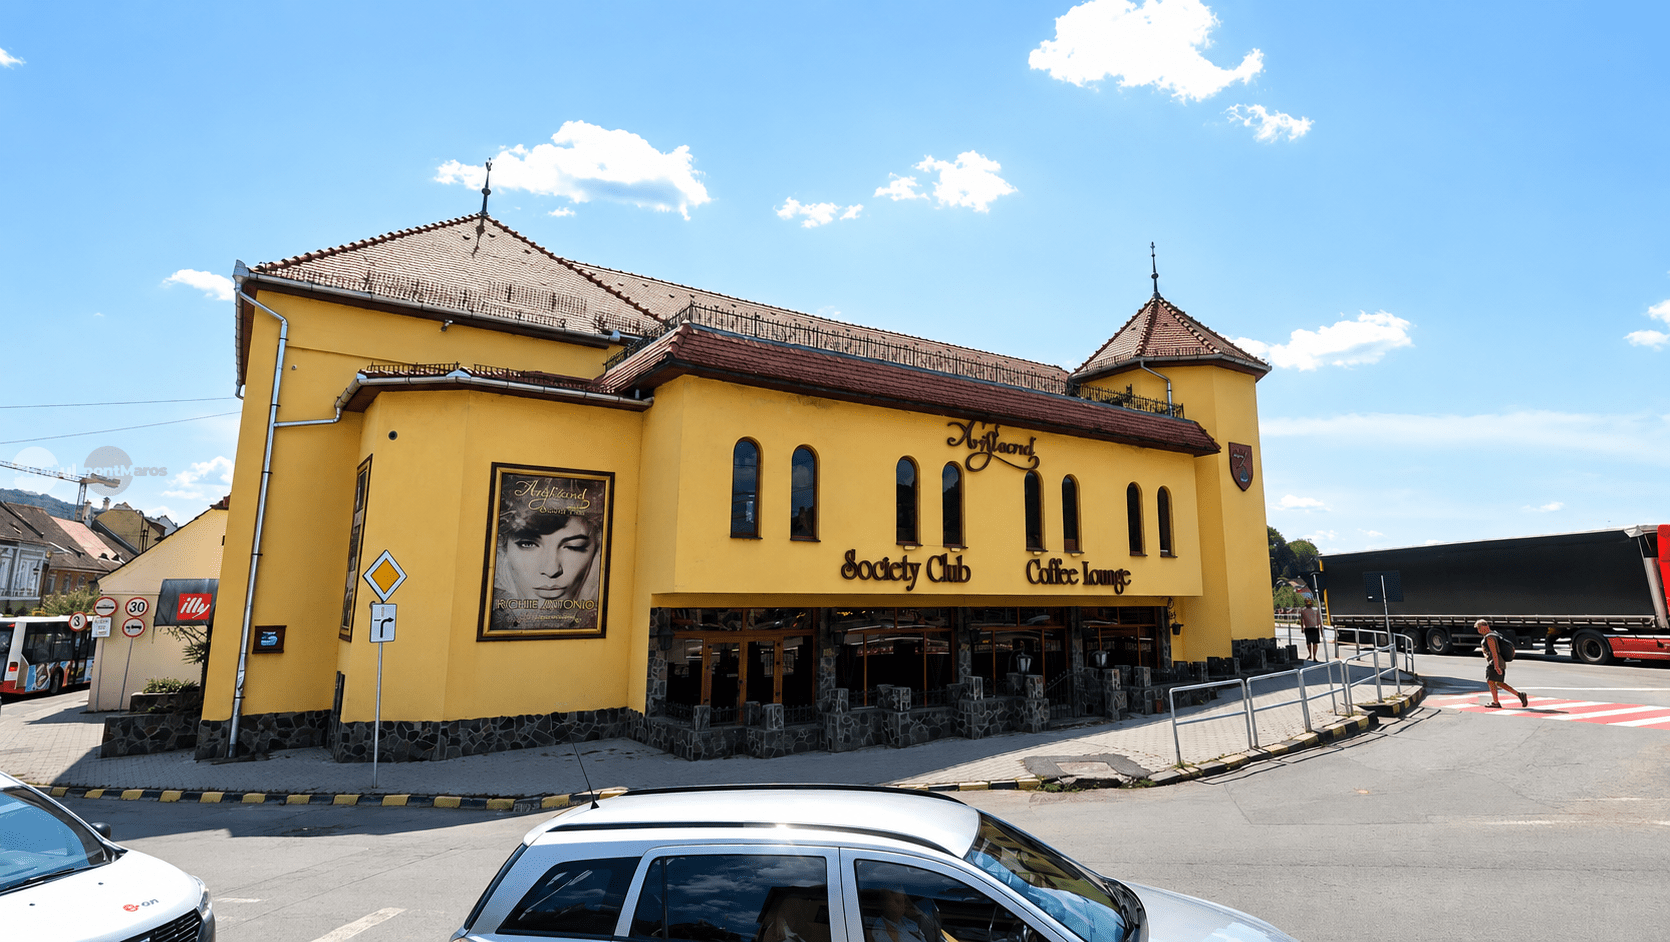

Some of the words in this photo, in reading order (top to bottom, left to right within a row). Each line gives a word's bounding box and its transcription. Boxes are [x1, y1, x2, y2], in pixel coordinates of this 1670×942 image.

[841, 549, 921, 591] Society
[926, 553, 971, 583] Club
[1026, 558, 1079, 585] Coffee
[129, 601, 145, 613] 30
[180, 597, 210, 618] illy
